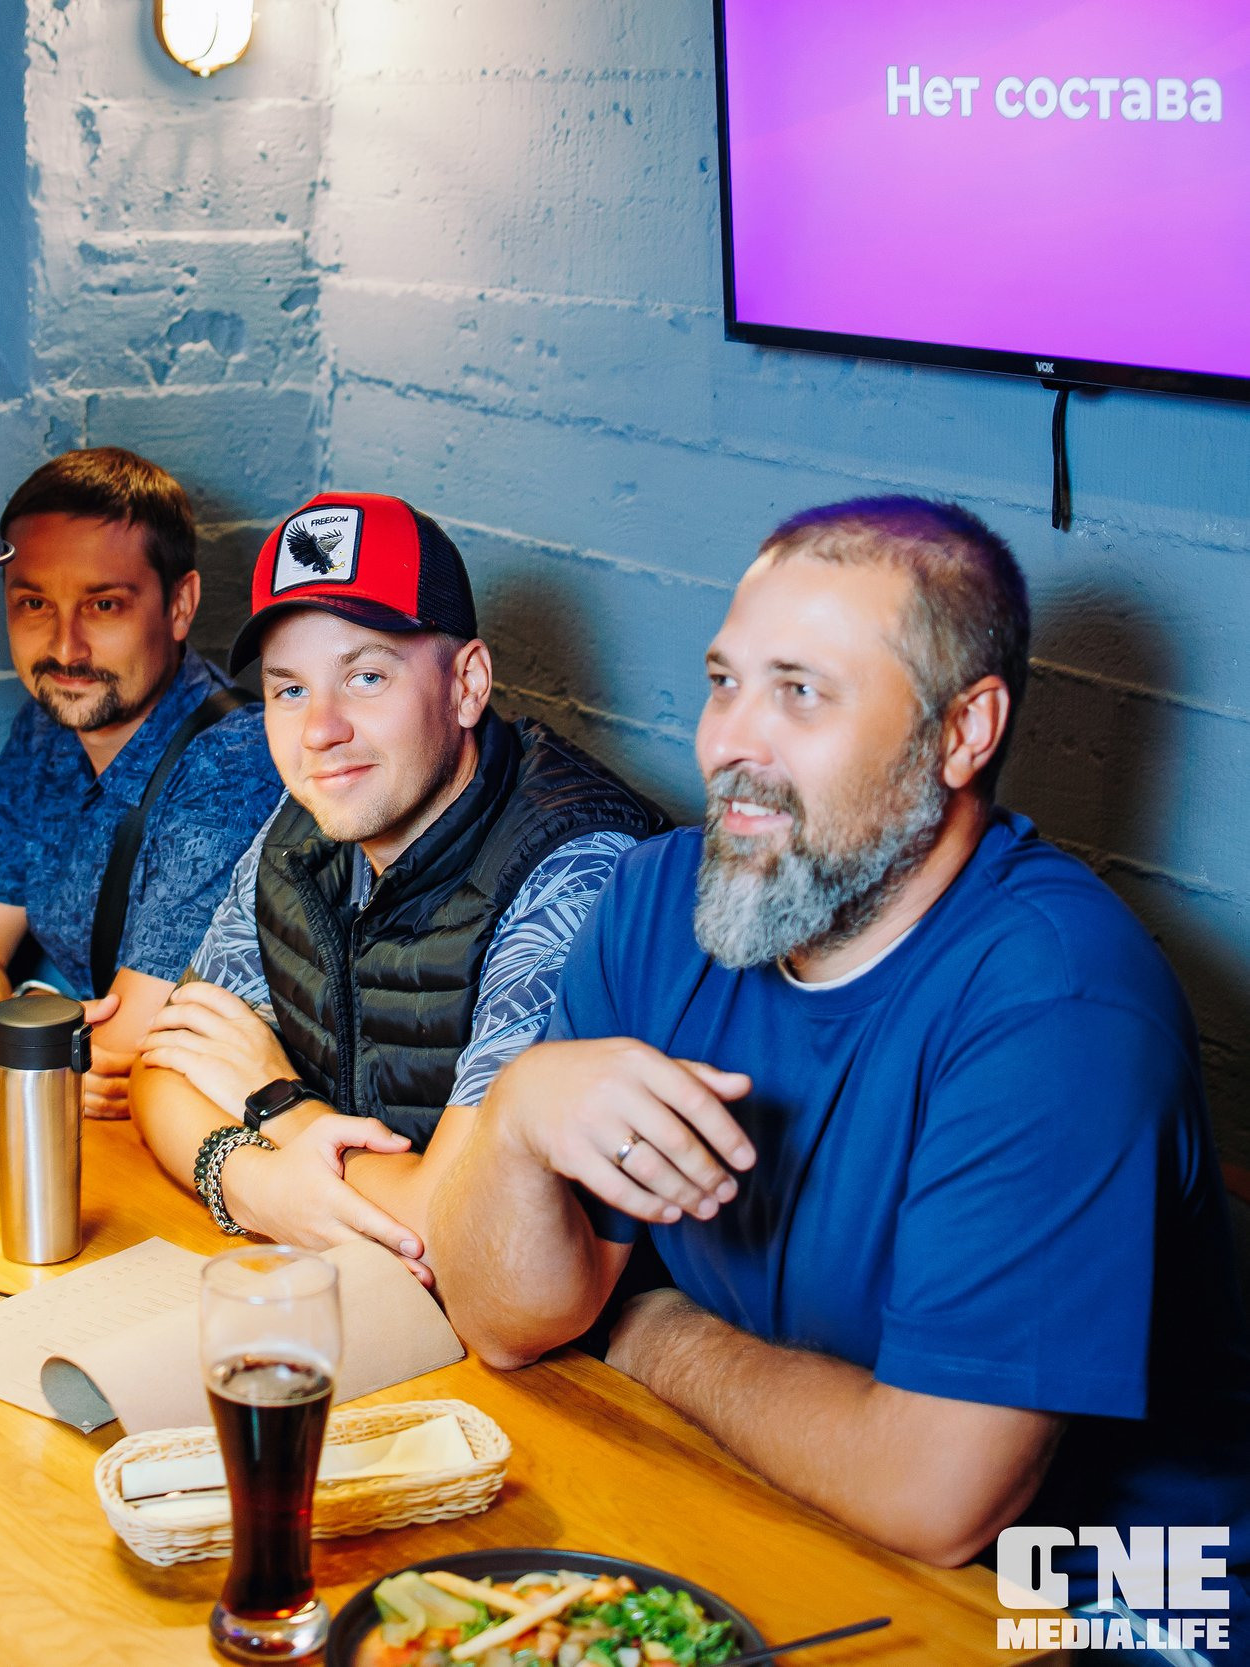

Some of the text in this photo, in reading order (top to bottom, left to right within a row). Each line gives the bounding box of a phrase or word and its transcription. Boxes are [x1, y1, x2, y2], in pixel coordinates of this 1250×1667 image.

[885, 65, 1223, 123] Нет состава
[1035, 361, 1055, 374] VOX
[310, 515, 349, 527] FREEDOM
